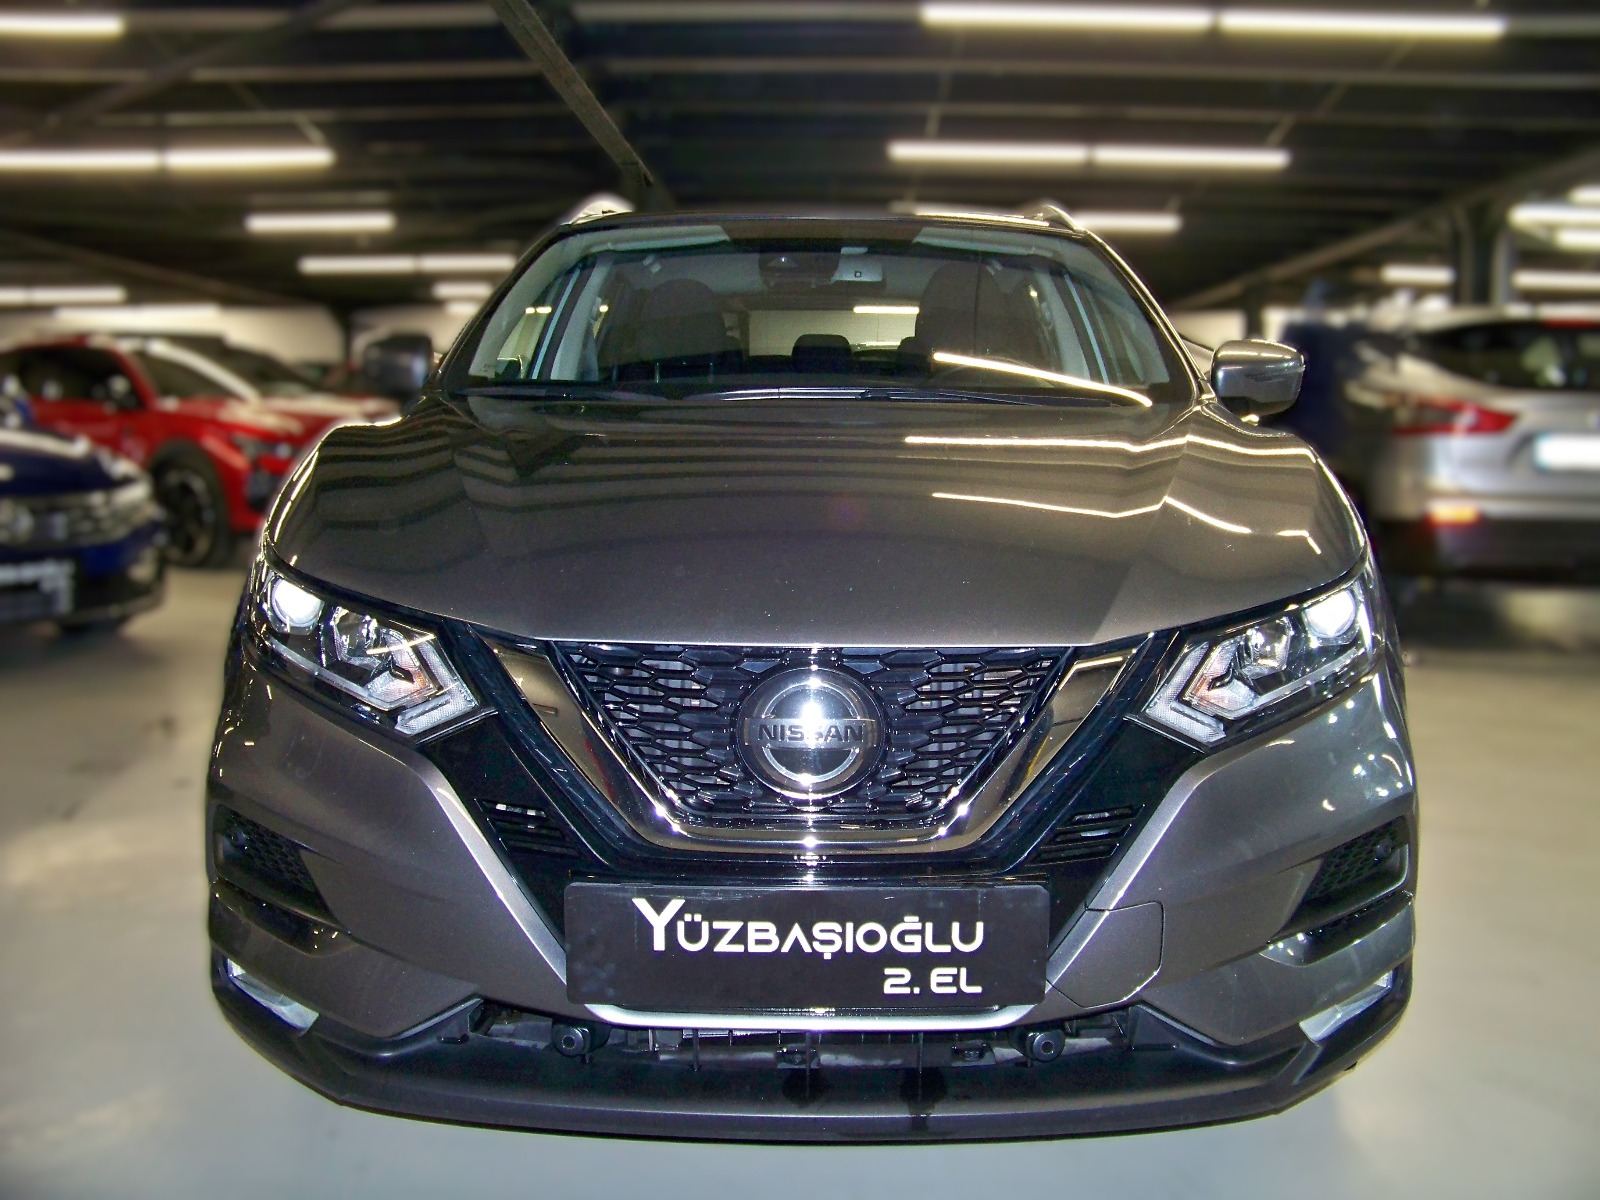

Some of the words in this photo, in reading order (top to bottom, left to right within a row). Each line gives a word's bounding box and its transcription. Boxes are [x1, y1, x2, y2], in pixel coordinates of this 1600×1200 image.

[632, 898, 984, 960] YÜZBAŞIOĞLU
[884, 967, 921, 994] 2.
[930, 967, 983, 994] EL
